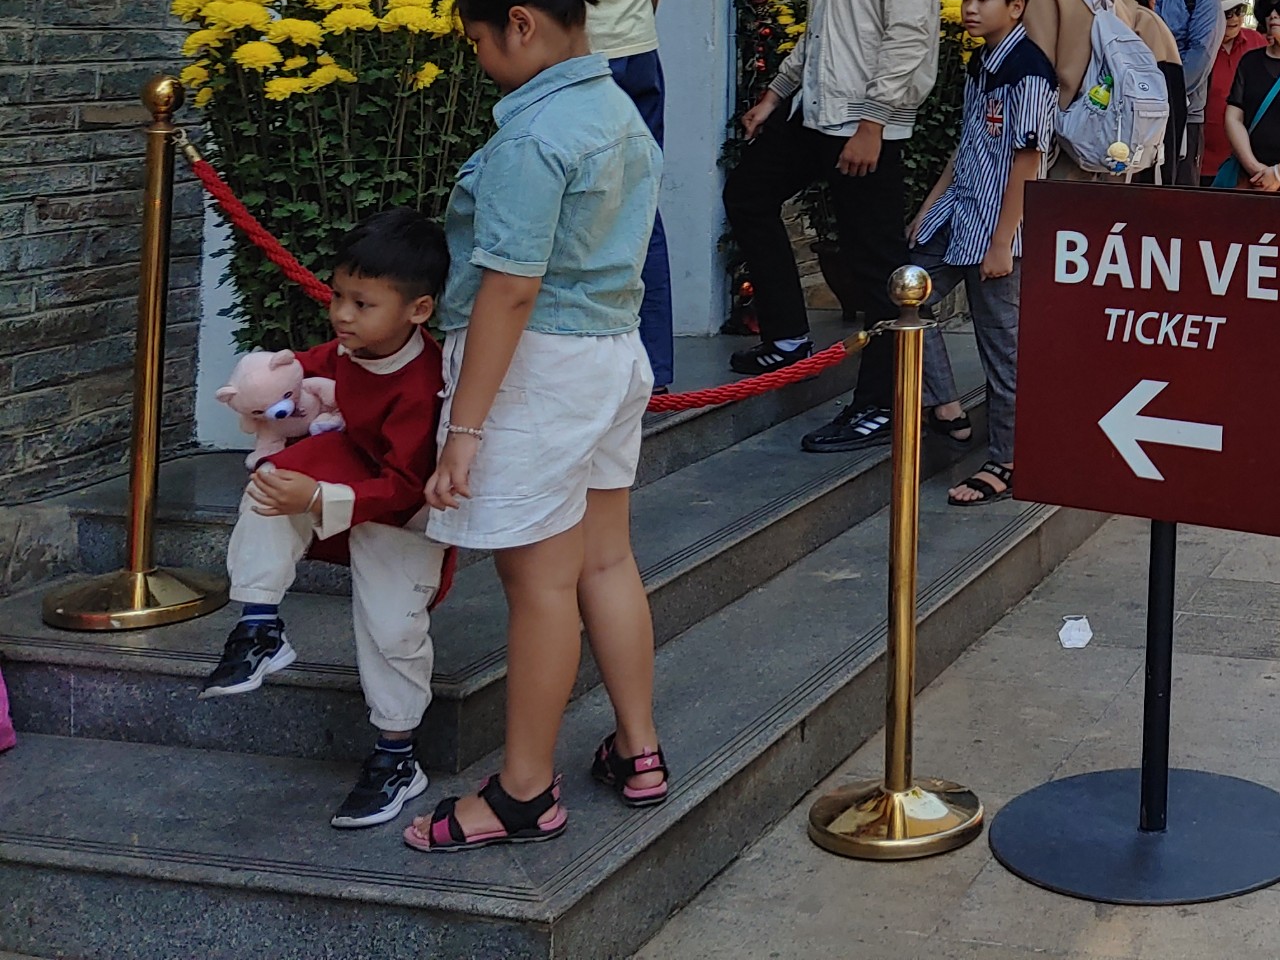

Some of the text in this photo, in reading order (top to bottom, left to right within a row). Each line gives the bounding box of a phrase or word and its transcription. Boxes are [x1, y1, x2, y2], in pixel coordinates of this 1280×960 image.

[1054, 222, 1280, 301] BÁN VÉ
[1104, 308, 1227, 350] TICKET
